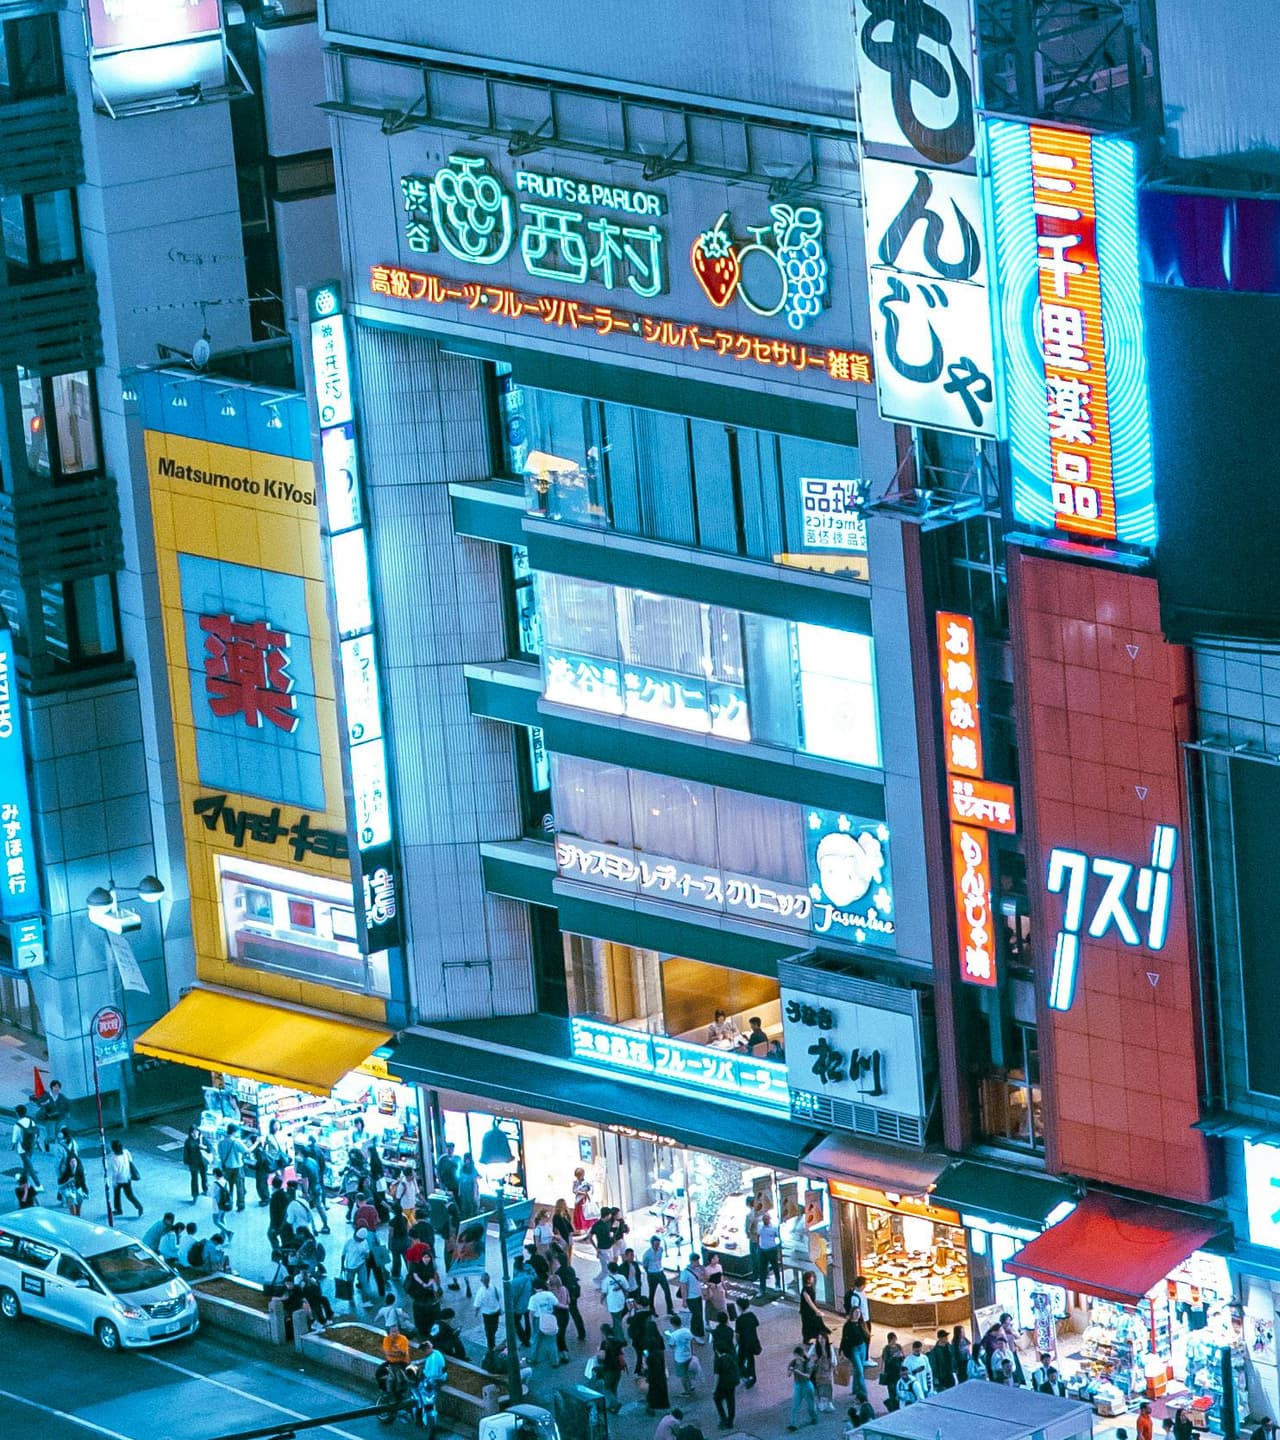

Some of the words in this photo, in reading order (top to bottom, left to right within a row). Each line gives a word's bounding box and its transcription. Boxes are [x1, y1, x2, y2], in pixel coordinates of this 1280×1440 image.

[400, 177, 432, 253] 渋谷
[520, 203, 663, 297] 西村
[1030, 154, 1099, 520] 三千里薬品
[157, 458, 260, 496] Matsumoto
[199, 614, 299, 733] 薬
[815, 904, 895, 935] Jasmine
[1047, 824, 1178, 1012] クスリ
